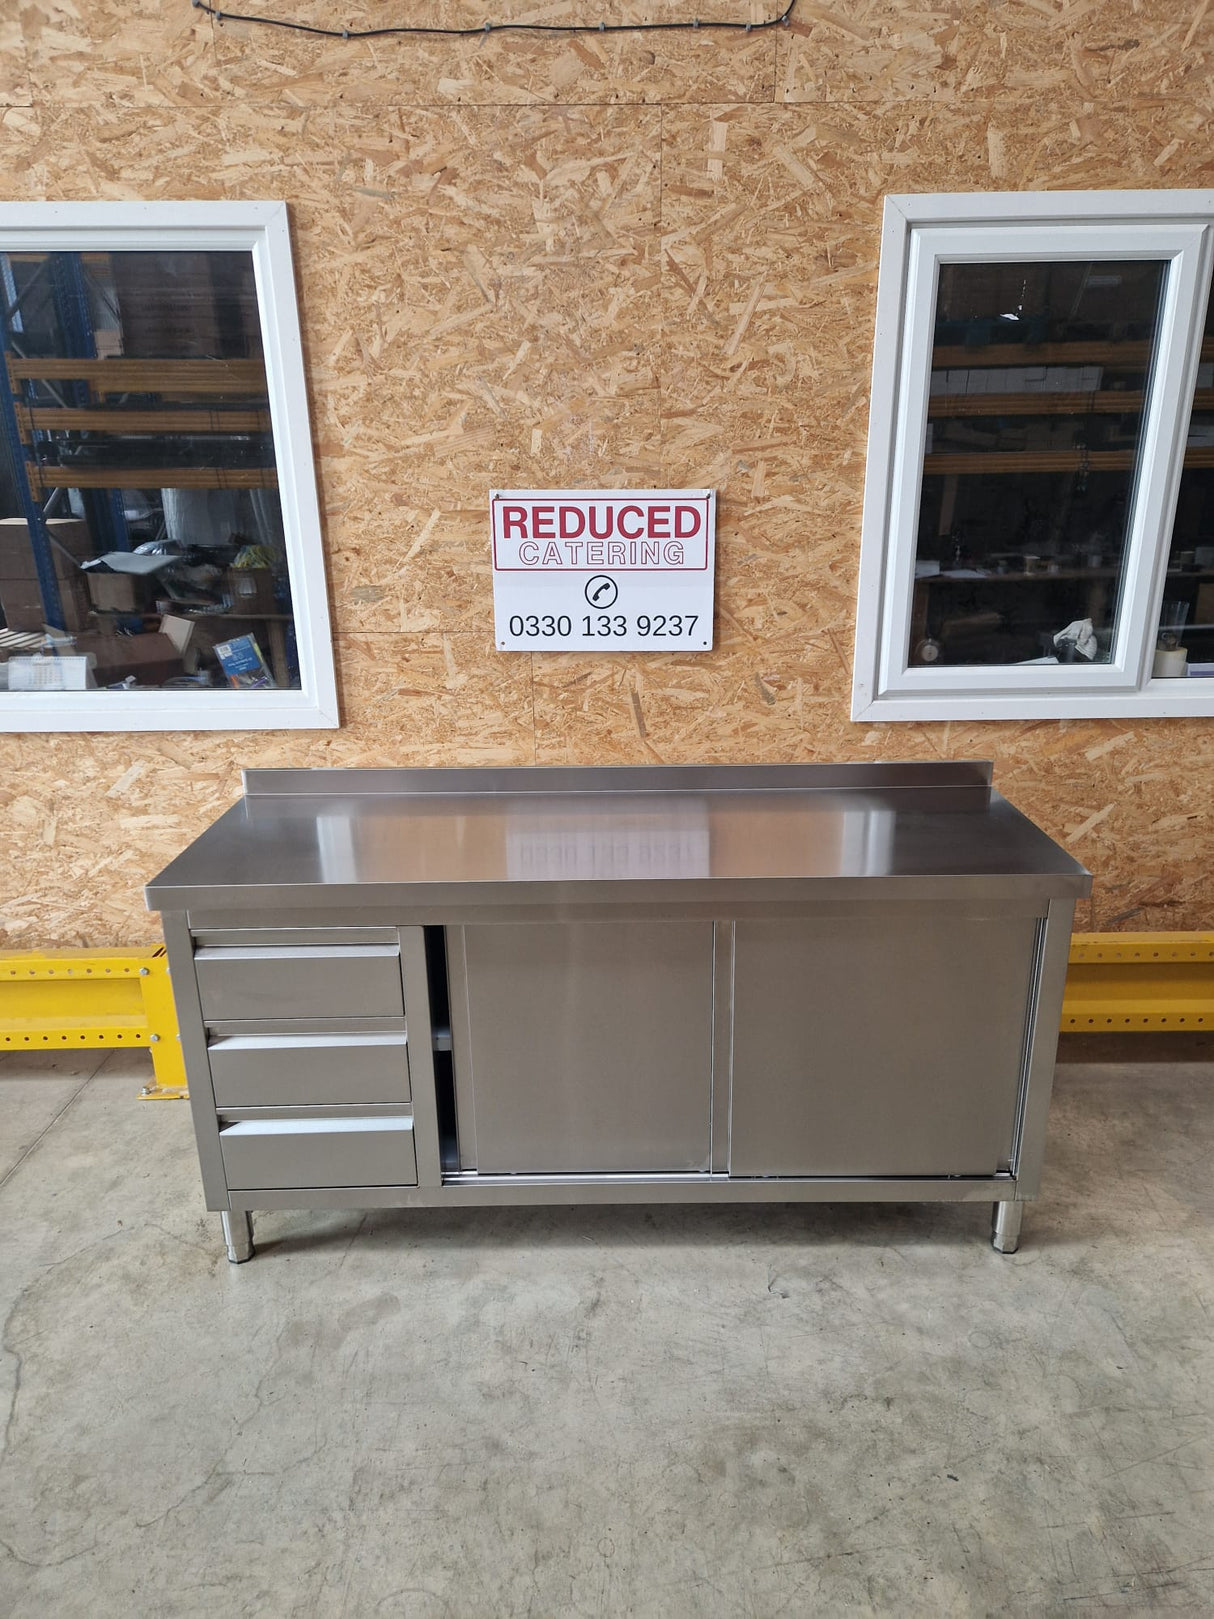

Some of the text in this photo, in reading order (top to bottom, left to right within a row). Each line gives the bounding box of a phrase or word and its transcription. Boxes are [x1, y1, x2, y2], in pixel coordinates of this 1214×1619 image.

[503, 505, 701, 539] REDUCED
[519, 541, 684, 565] CATERING
[509, 615, 698, 636] 0330 133 9237
